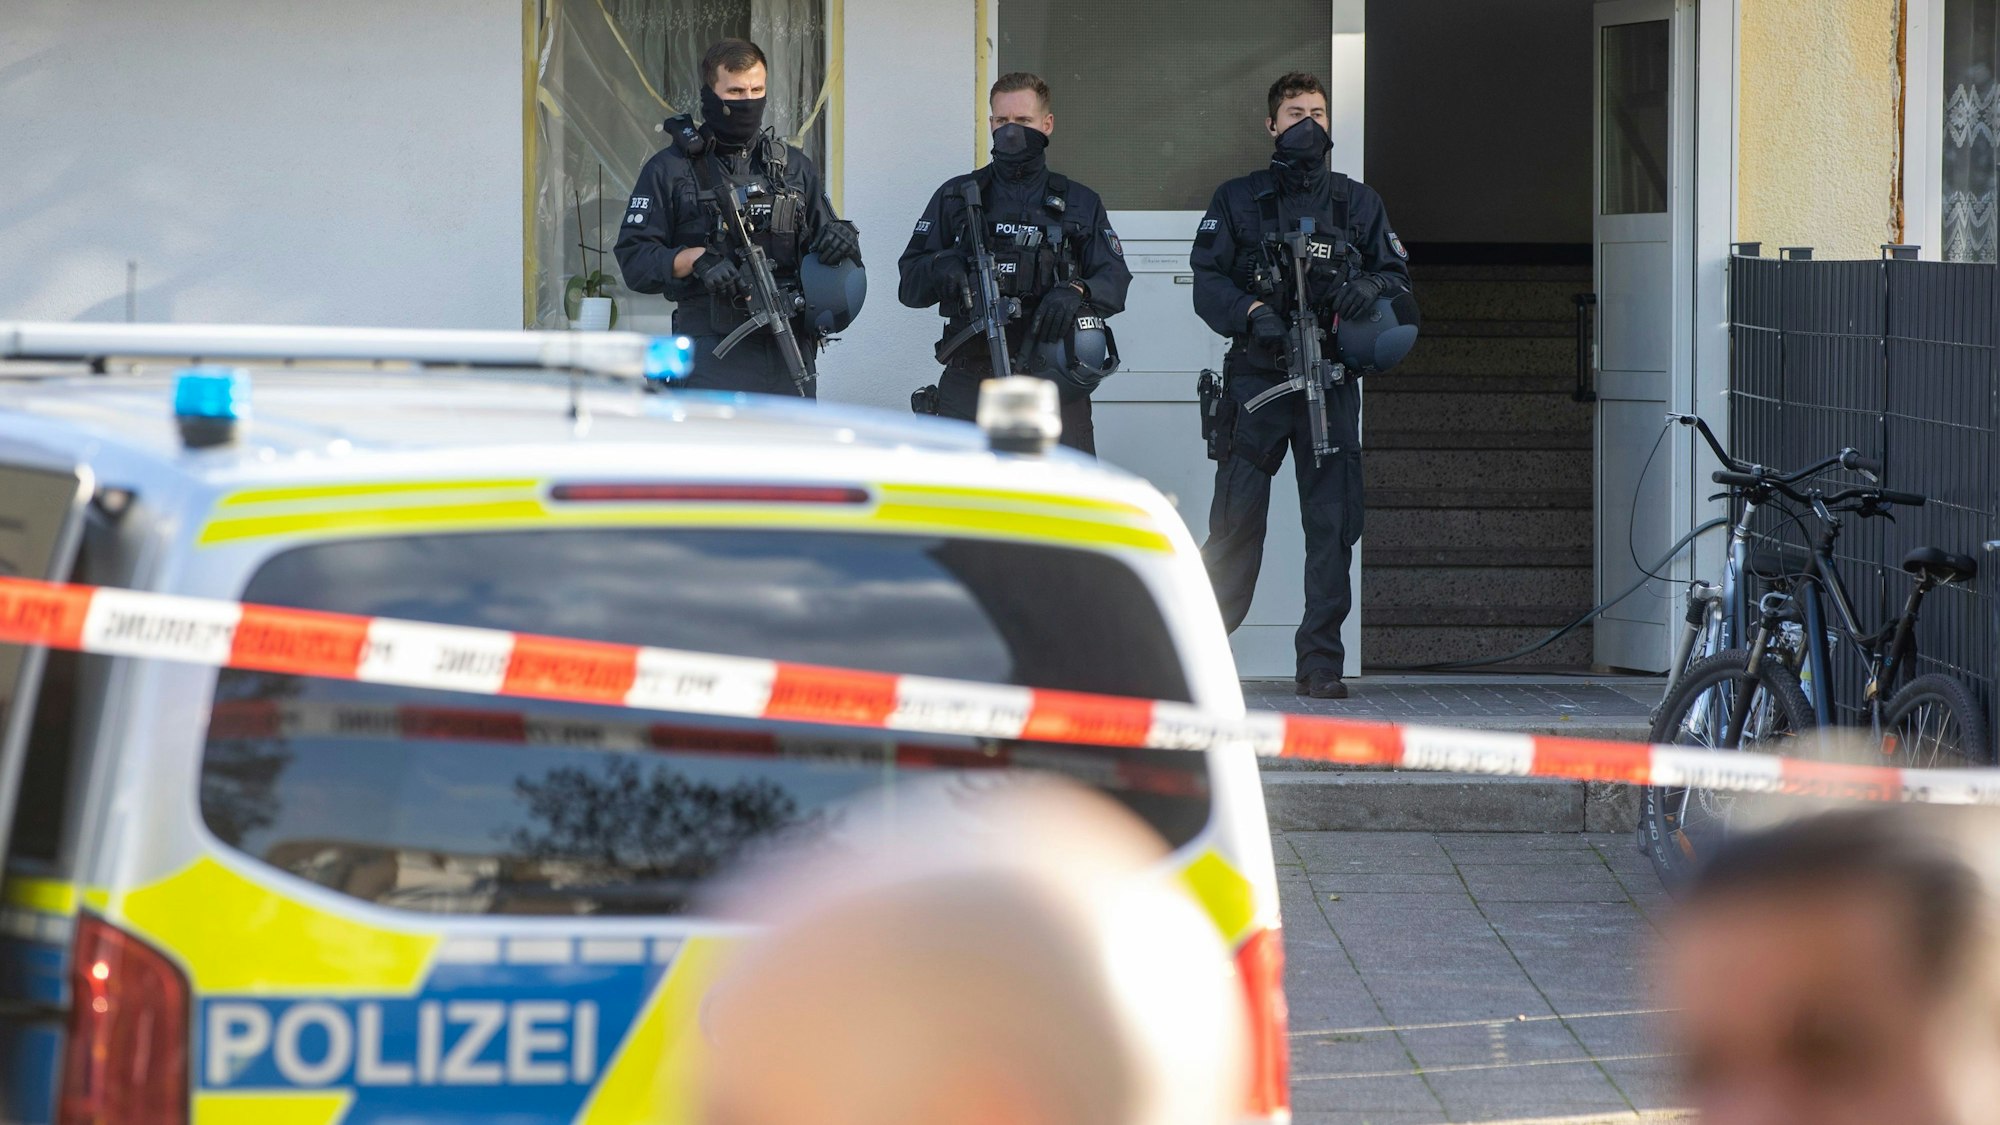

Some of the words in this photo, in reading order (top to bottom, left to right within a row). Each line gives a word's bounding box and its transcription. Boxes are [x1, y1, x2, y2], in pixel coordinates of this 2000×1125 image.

[630, 197, 650, 209] BFE
[997, 263, 1017, 273] IZEI
[1647, 783, 1656, 815] PAC
[1648, 820, 1660, 841] OF
[206, 1001, 599, 1086] POLIZEI
